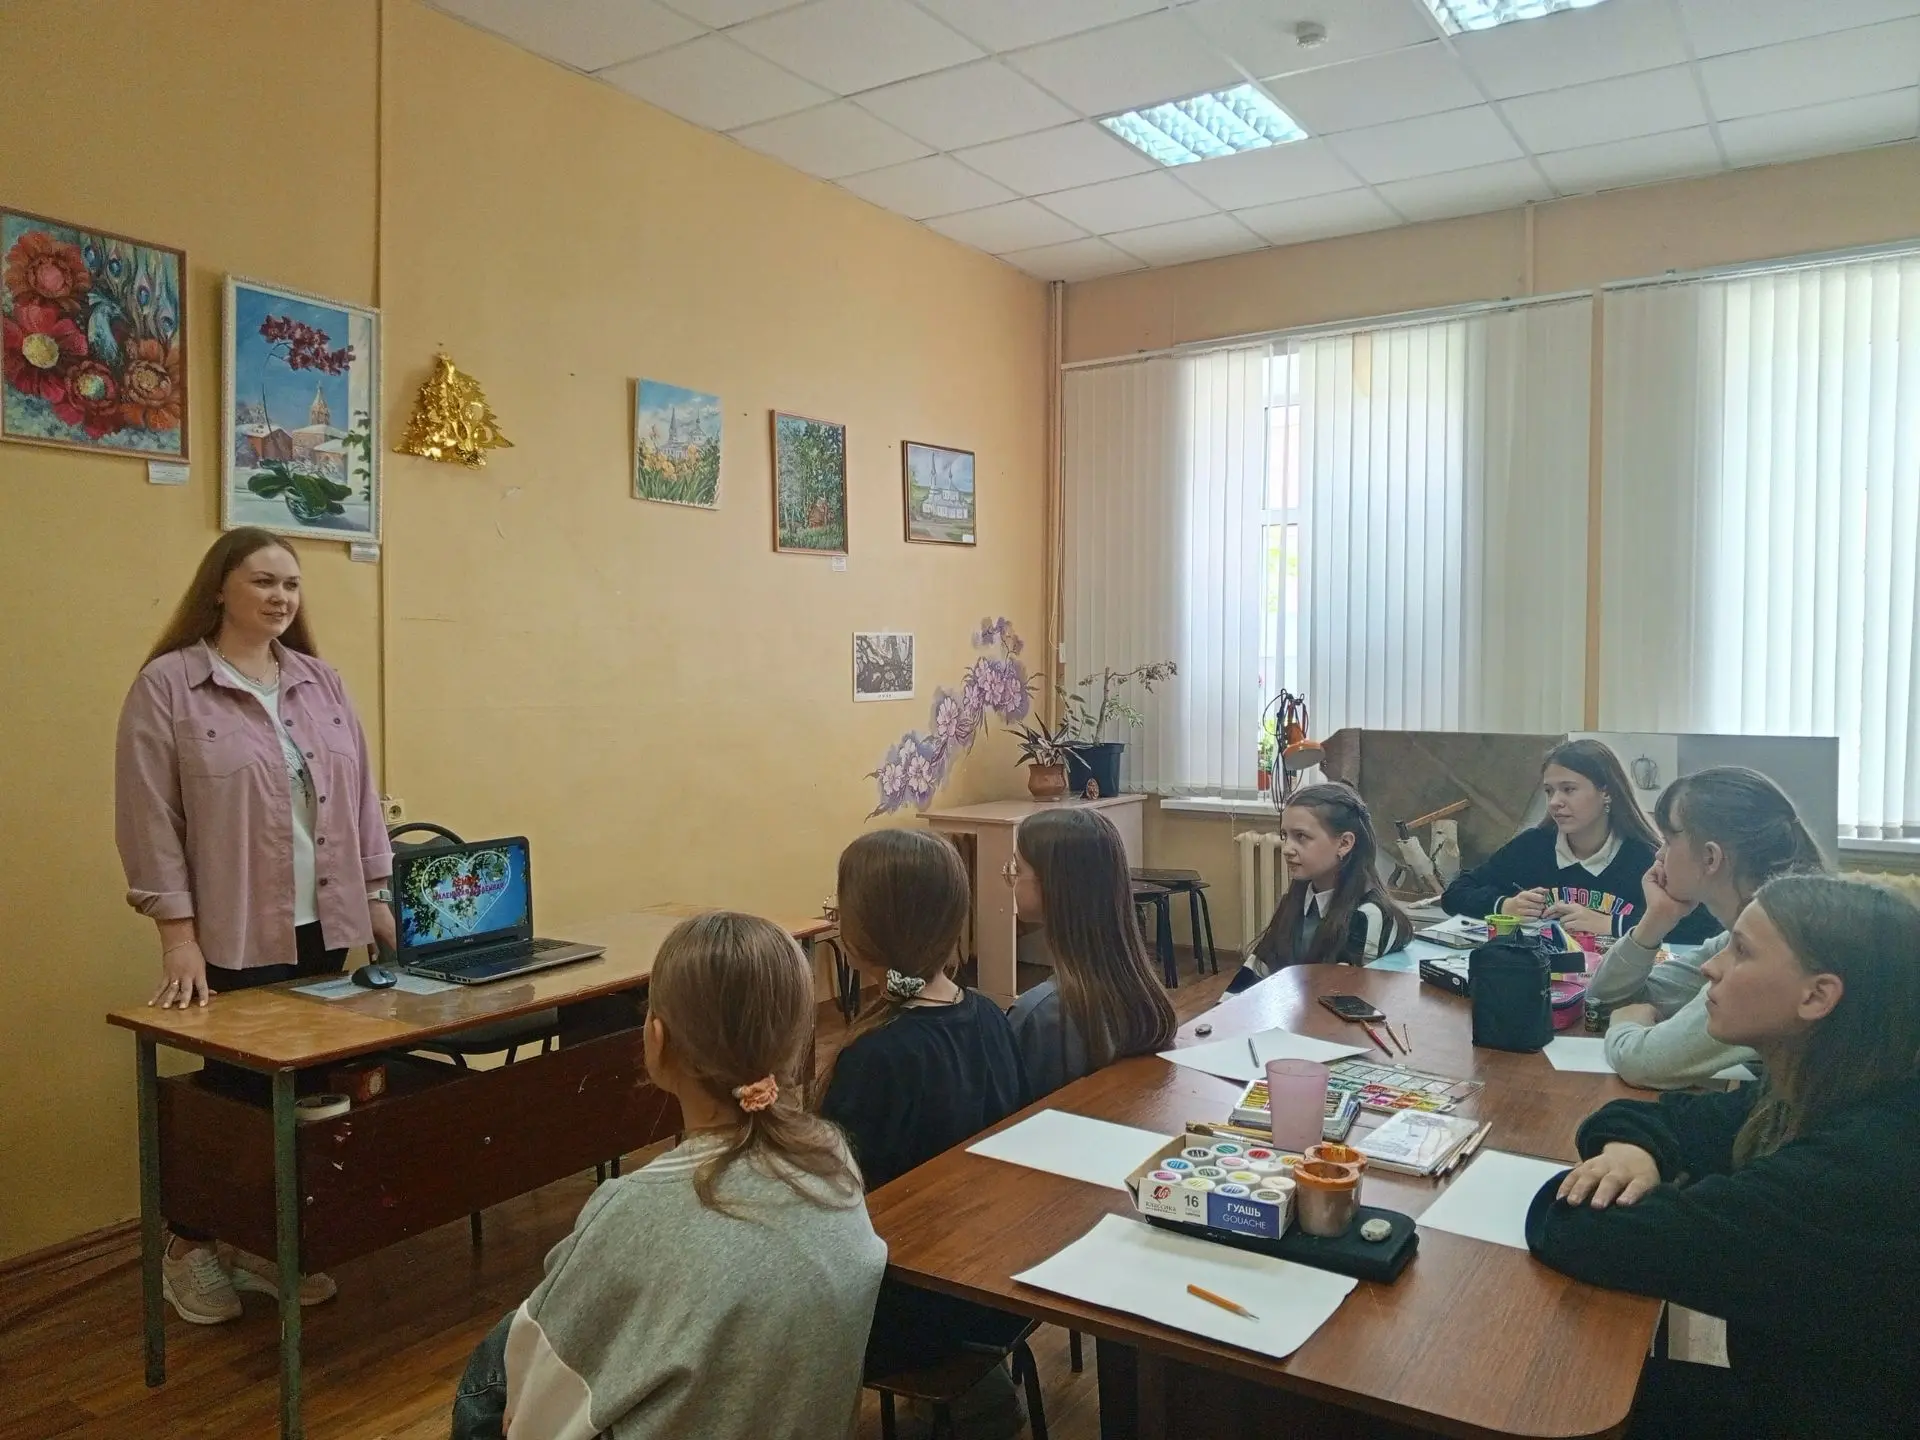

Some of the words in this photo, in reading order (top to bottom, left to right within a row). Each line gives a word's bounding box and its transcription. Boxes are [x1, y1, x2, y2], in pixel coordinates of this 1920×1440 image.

[1545, 886, 1634, 915] ALIFORNIA
[1184, 1194, 1200, 1208] 16
[1227, 1202, 1261, 1218] ГУАШЬ
[1222, 1213, 1267, 1230] GOUACHE
